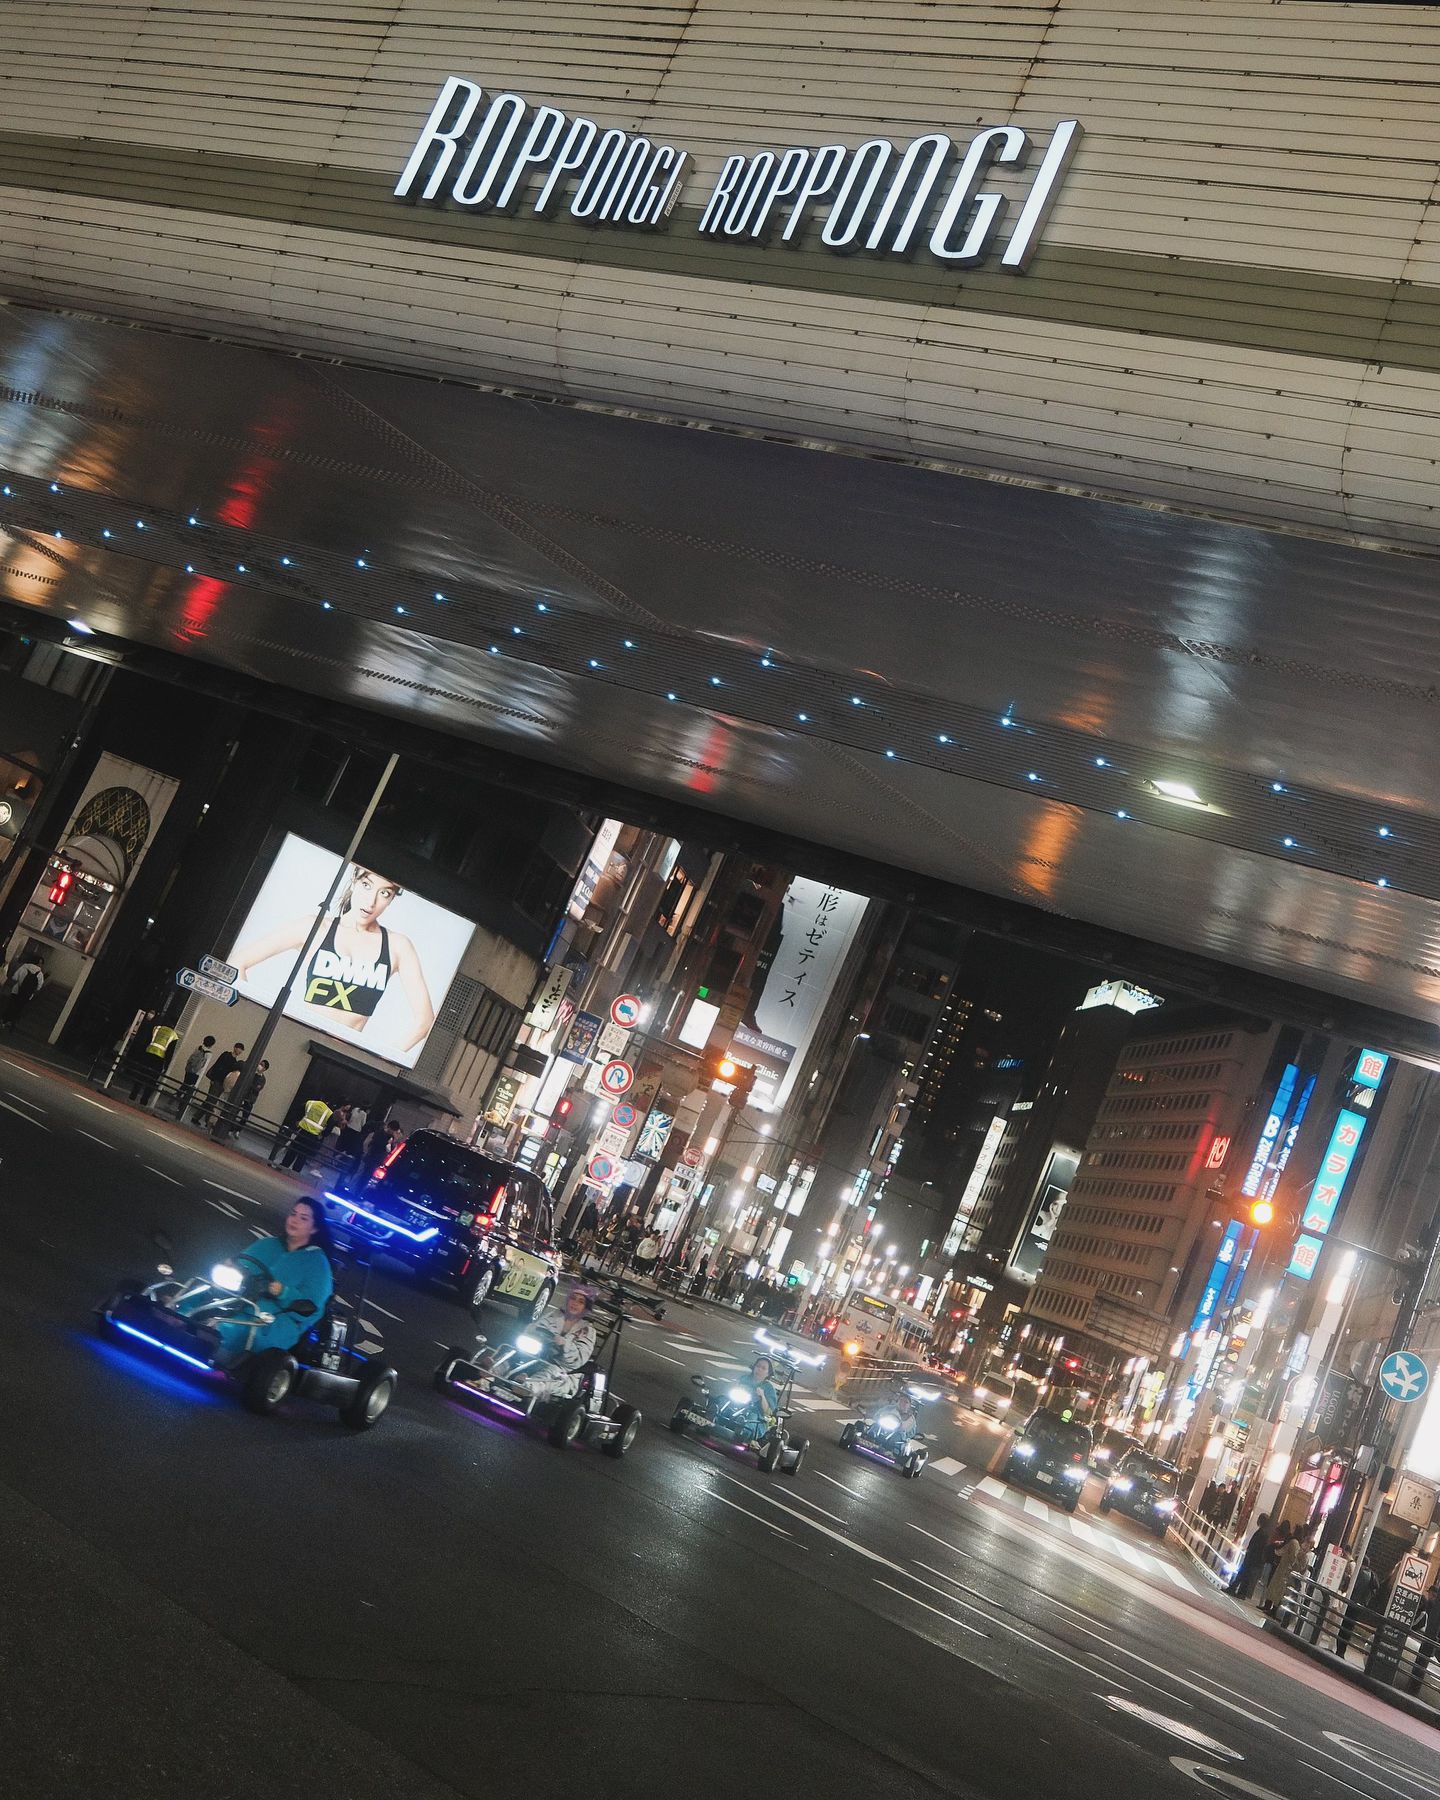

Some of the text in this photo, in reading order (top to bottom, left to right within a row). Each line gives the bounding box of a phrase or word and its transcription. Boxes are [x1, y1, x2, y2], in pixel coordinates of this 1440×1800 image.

[394, 75, 688, 225] ROPPONGI
[699, 120, 1081, 267] ROPPONGI
[779, 885, 841, 1007] 形はゼティス
[312, 948, 388, 991] DMM
[304, 977, 358, 1012] FX
[755, 1063, 779, 1080] Clinic
[1362, 1056, 1384, 1079] 館
